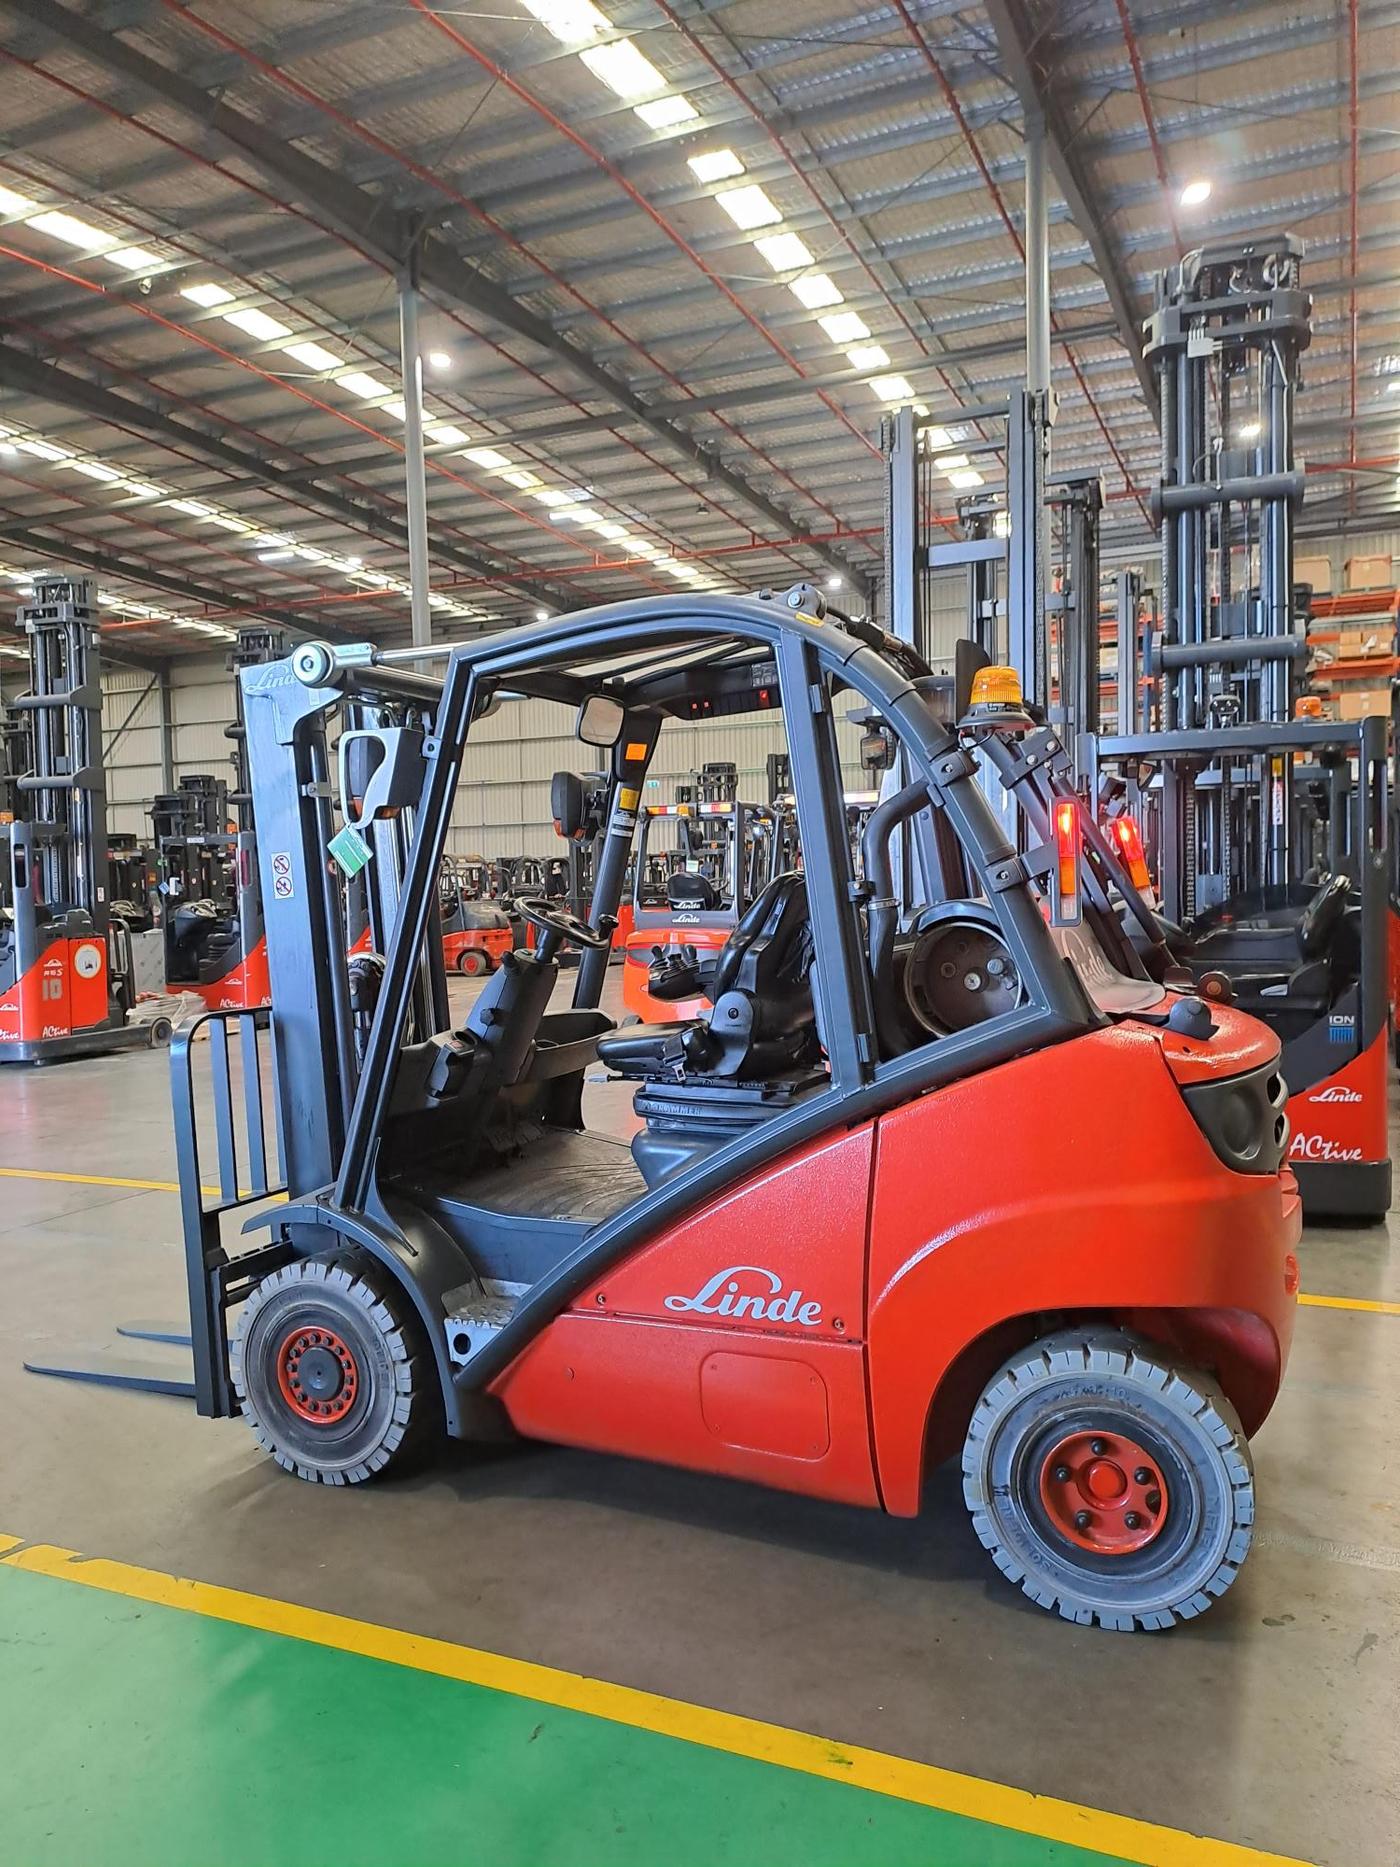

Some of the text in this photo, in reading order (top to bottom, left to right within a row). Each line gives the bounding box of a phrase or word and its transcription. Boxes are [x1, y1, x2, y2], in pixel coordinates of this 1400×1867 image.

[672, 914, 700, 922] Linde
[1329, 1015, 1355, 1024] ION
[1308, 1086, 1362, 1103] Linde
[1289, 1133, 1362, 1161] ACtive
[664, 1265, 824, 1326] Linde
